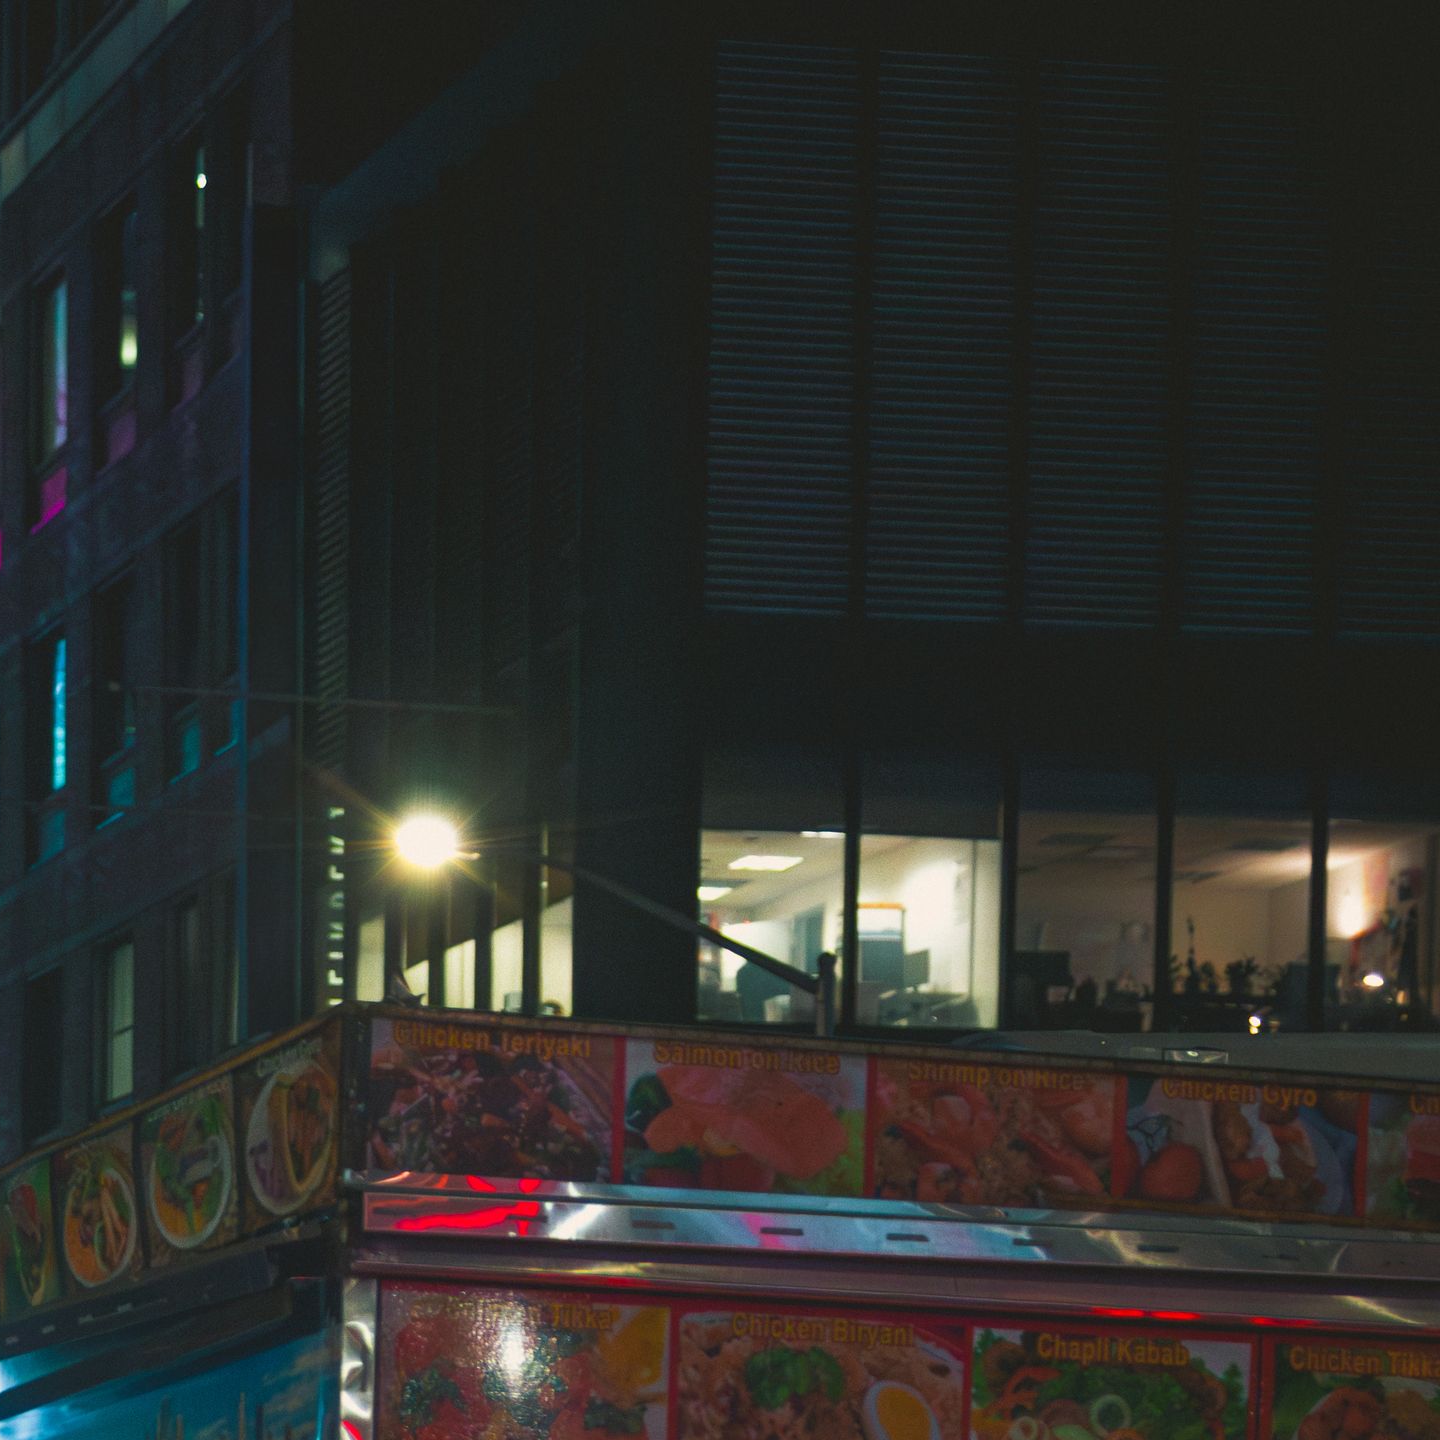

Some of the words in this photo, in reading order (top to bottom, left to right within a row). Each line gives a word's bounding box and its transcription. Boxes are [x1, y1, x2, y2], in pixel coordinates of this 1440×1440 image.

[393, 1020, 491, 1052] Chicken
[500, 1029, 592, 1061] Teriyaki
[654, 1040, 743, 1070] Salmon
[748, 1050, 781, 1072] on
[787, 1050, 841, 1075] Rice
[909, 1063, 991, 1090] Shrimp
[1028, 1070, 1085, 1093] Rice
[1161, 1077, 1257, 1103] Chicken
[1262, 1084, 1318, 1109] Gyro
[732, 1312, 824, 1342] Chicken
[831, 1317, 915, 1349] Biryani
[1037, 1333, 1111, 1364] Chapli
[1116, 1338, 1190, 1368] Kabab
[1289, 1343, 1382, 1376] Chicken
